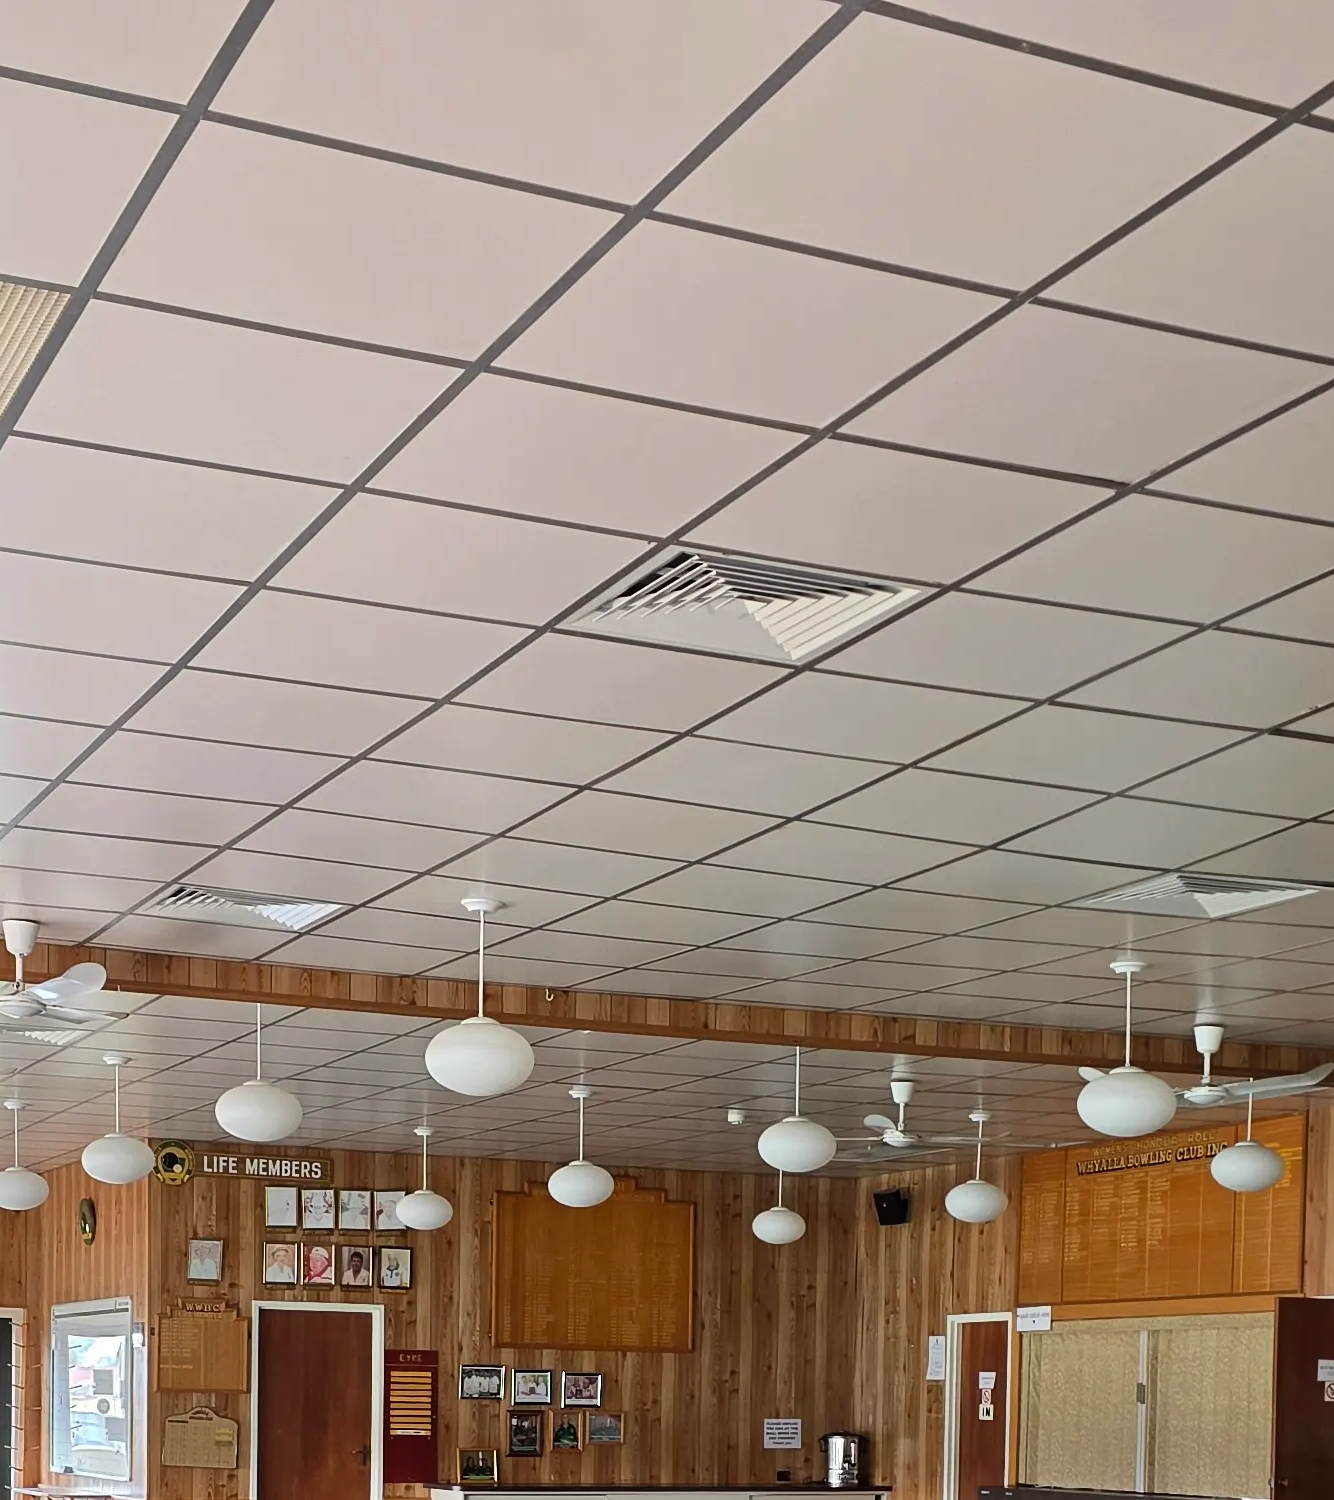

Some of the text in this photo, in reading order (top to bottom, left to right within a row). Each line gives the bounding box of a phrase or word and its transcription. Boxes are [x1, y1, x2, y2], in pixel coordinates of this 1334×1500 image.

[1136, 1136, 1178, 1150] HONOUR
[1187, 1131, 1216, 1144] ROLL
[203, 1155, 322, 1179] LIFE MEMBERS
[1077, 1156, 1126, 1175] WHYALLA
[1127, 1149, 1173, 1168] BOWLING
[1175, 1145, 1205, 1162] CLUB
[982, 1407, 991, 1417] IN
